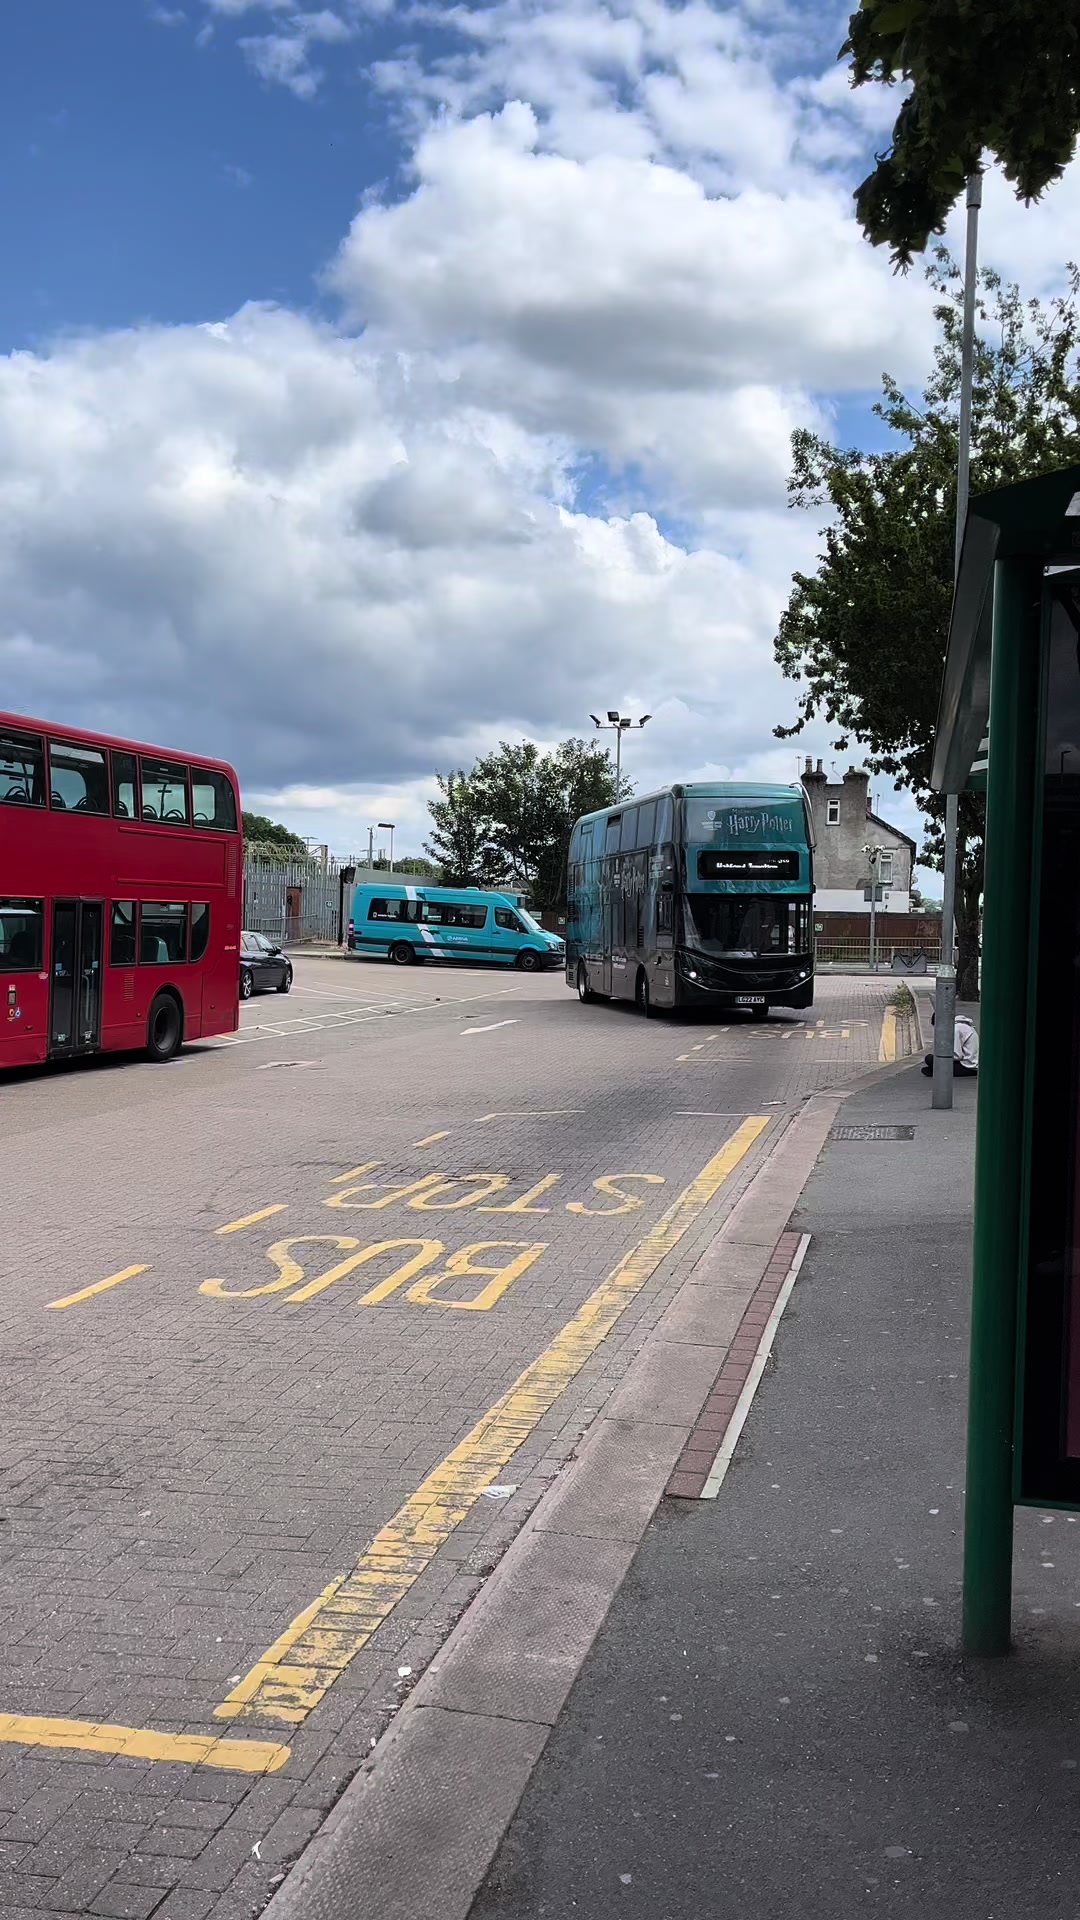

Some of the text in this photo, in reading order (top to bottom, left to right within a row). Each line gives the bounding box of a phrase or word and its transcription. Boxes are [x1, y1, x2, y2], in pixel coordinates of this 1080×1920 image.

[727, 814, 760, 836] Harry
[761, 812, 793, 836] Potter
[747, 1029, 849, 1039] BUS
[322, 1173, 665, 1215] STOP
[199, 1236, 547, 1310] BUS
